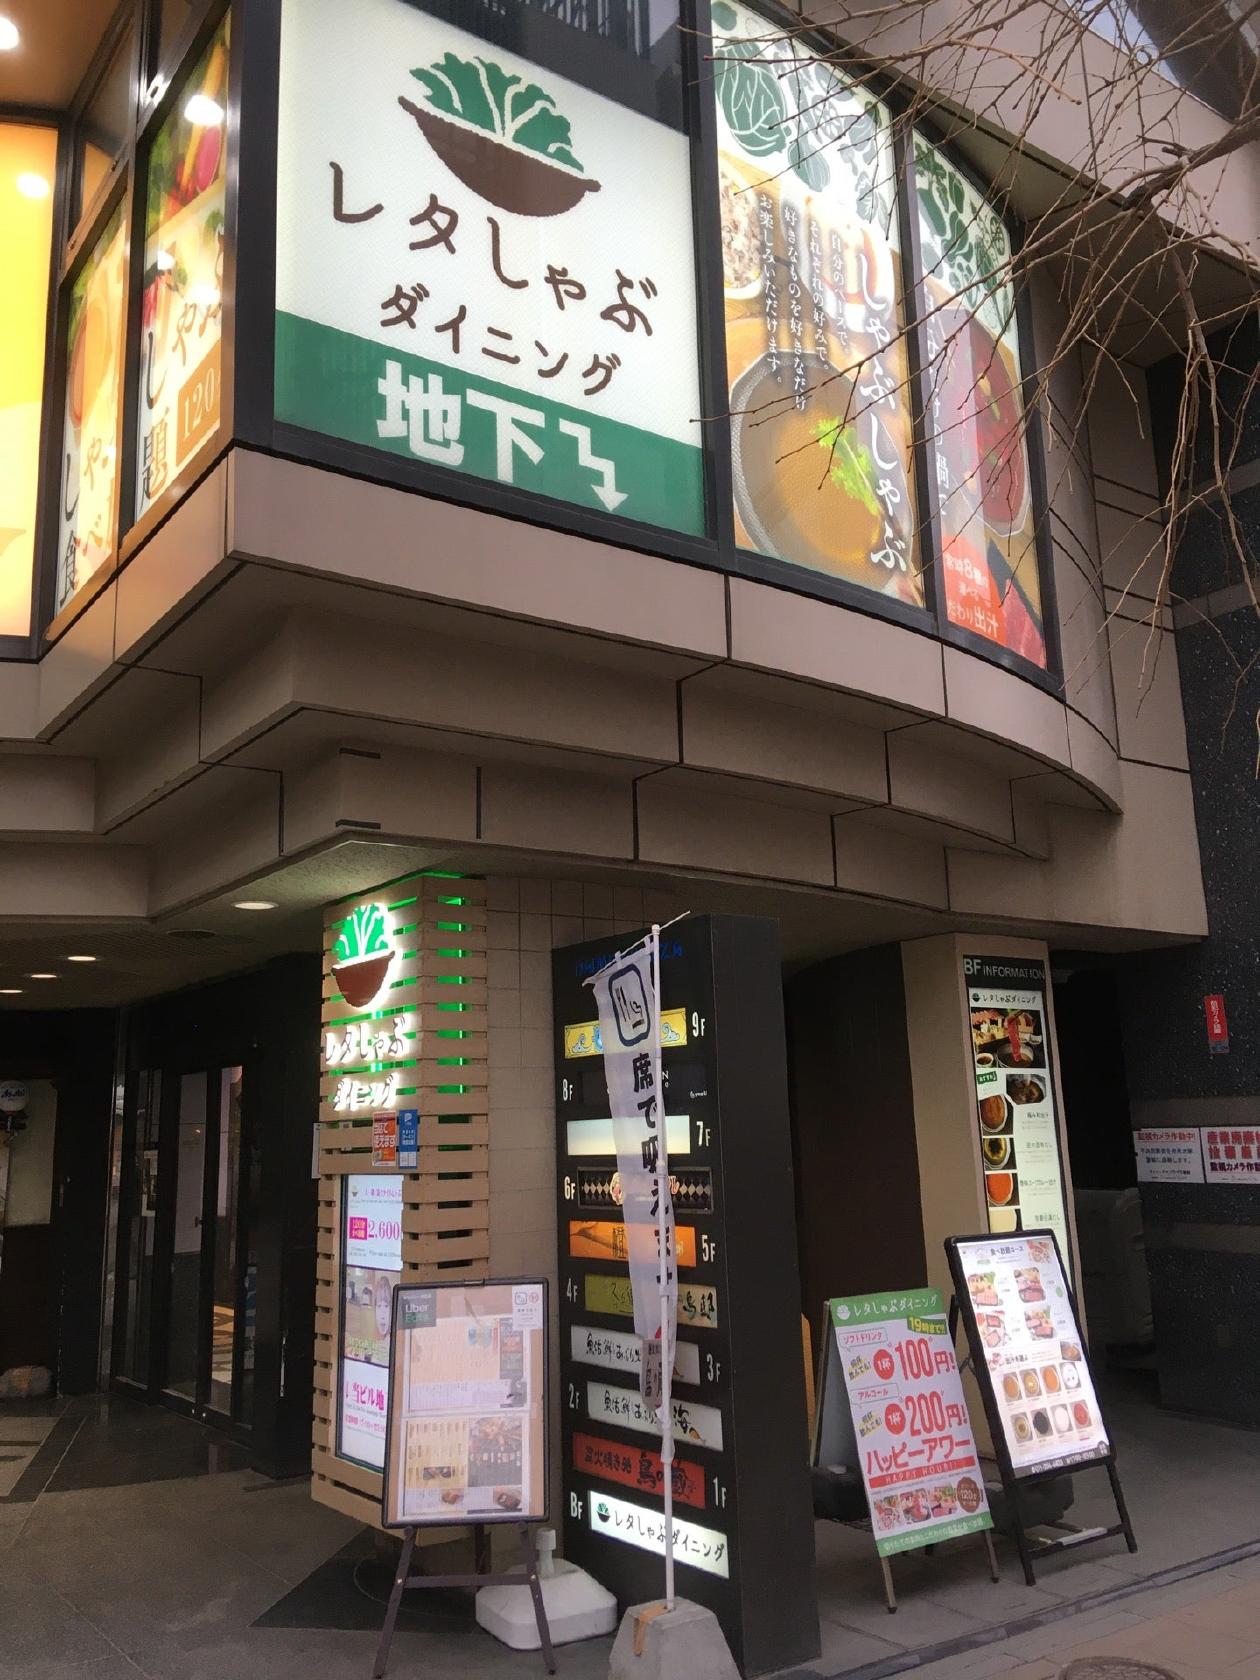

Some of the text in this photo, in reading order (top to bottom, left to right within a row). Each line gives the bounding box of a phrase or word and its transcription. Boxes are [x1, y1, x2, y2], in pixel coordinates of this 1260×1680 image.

[329, 161, 659, 337] レタしゃぶ
[380, 283, 623, 396] ダイニング
[376, 359, 546, 484] 地下
[860, 252, 908, 573] しゃぶしゃぶ
[964, 958, 1045, 979] BF INFORMATION
[692, 1011, 706, 1037] 9F
[562, 1078, 574, 1102] 8F
[696, 1121, 711, 1147] 7F
[564, 1176, 576, 1200] 6F
[701, 1234, 716, 1262] 5F
[566, 1277, 578, 1302] 4F
[852, 1294, 937, 1317] レタしゃぶダイニング
[841, 1330, 884, 1344] ソフトドリンク
[706, 1353, 721, 1383] 3F
[568, 1383, 580, 1410] 2F
[857, 1388, 889, 1401] アルコール
[865, 1434, 971, 1475] ハッピーアワー
[885, 1470, 917, 1484] HAPPY
[570, 1490, 583, 1520] BF
[713, 1475, 728, 1509] 1F
[614, 1509, 726, 1563] レタしゃぶダイニング
